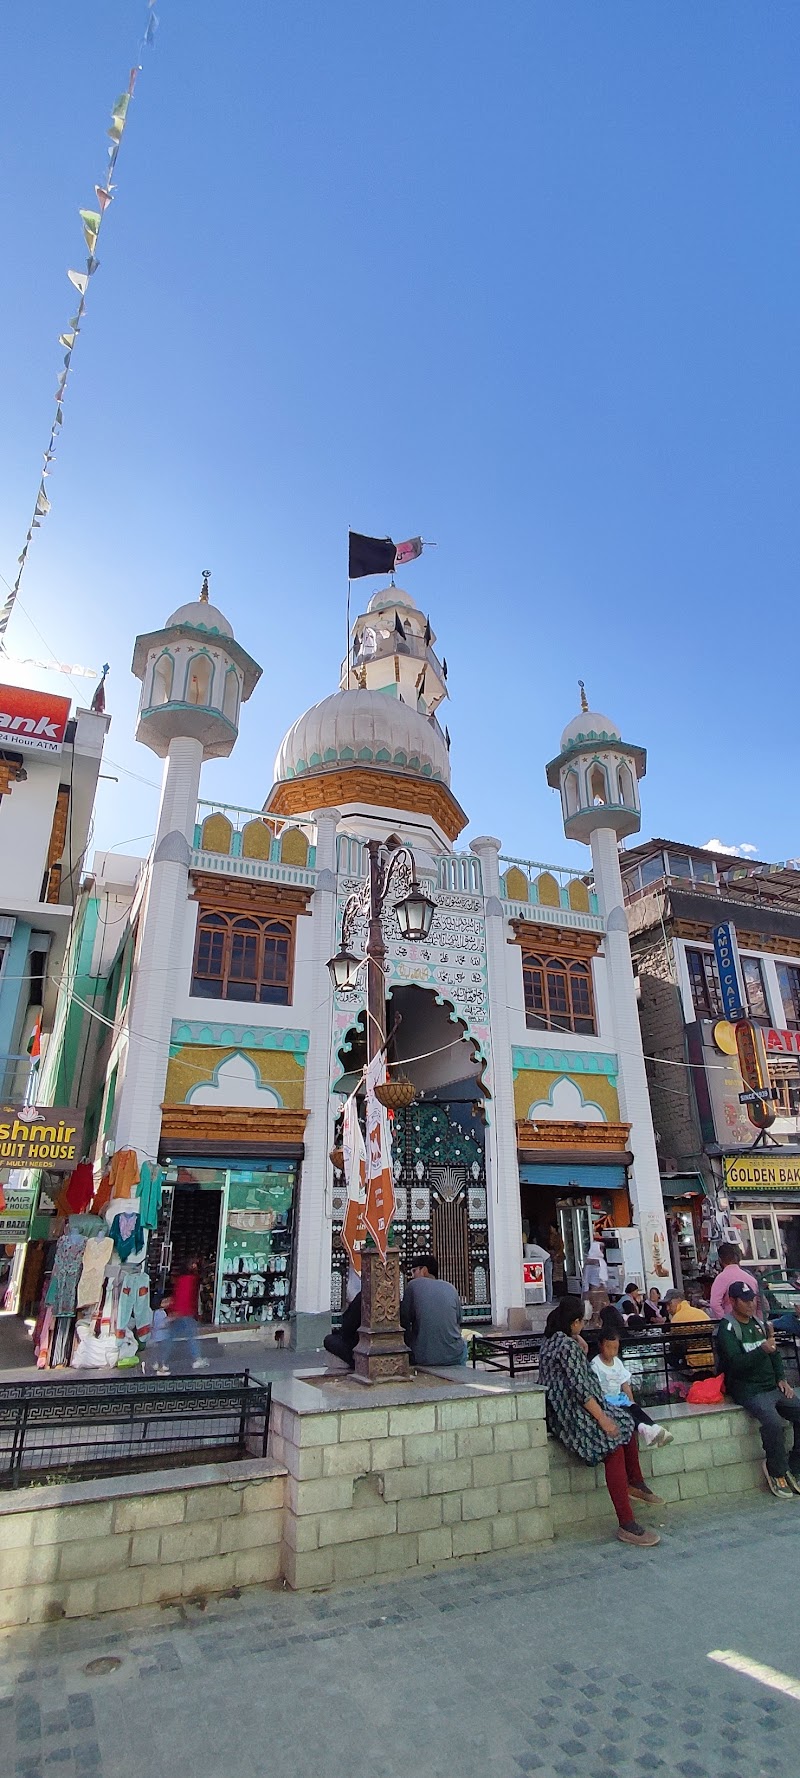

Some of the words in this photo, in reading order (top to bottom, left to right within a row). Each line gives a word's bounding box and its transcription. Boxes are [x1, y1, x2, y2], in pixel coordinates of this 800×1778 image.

[11, 736, 34, 746] Hour
[37, 741, 58, 751] ATM
[717, 926, 731, 968] AMDO
[724, 974, 738, 1019] CAFE
[740, 1094, 756, 1102] SINCE
[0, 1143, 26, 1158] UIT
[28, 1144, 76, 1160] HOUSE
[730, 1168, 776, 1182] GOLDEN
